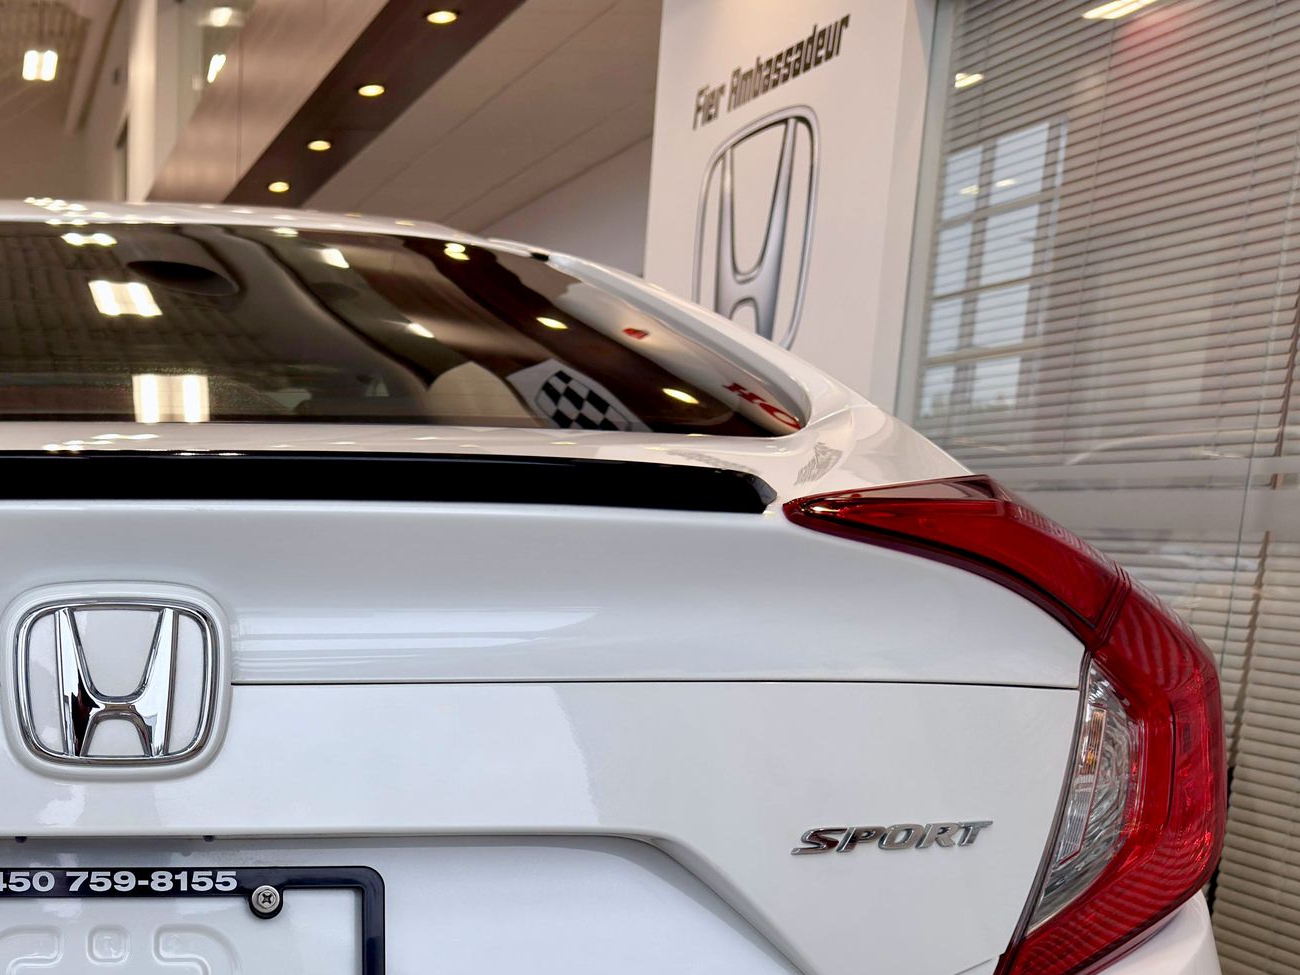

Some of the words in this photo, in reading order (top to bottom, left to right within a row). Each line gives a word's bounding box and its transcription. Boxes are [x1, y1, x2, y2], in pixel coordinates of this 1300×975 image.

[692, 84, 726, 131] Fier
[727, 14, 850, 113] Ambassadeur
[790, 820, 993, 856] SPORT
[65, 870, 238, 892] 759-8155
